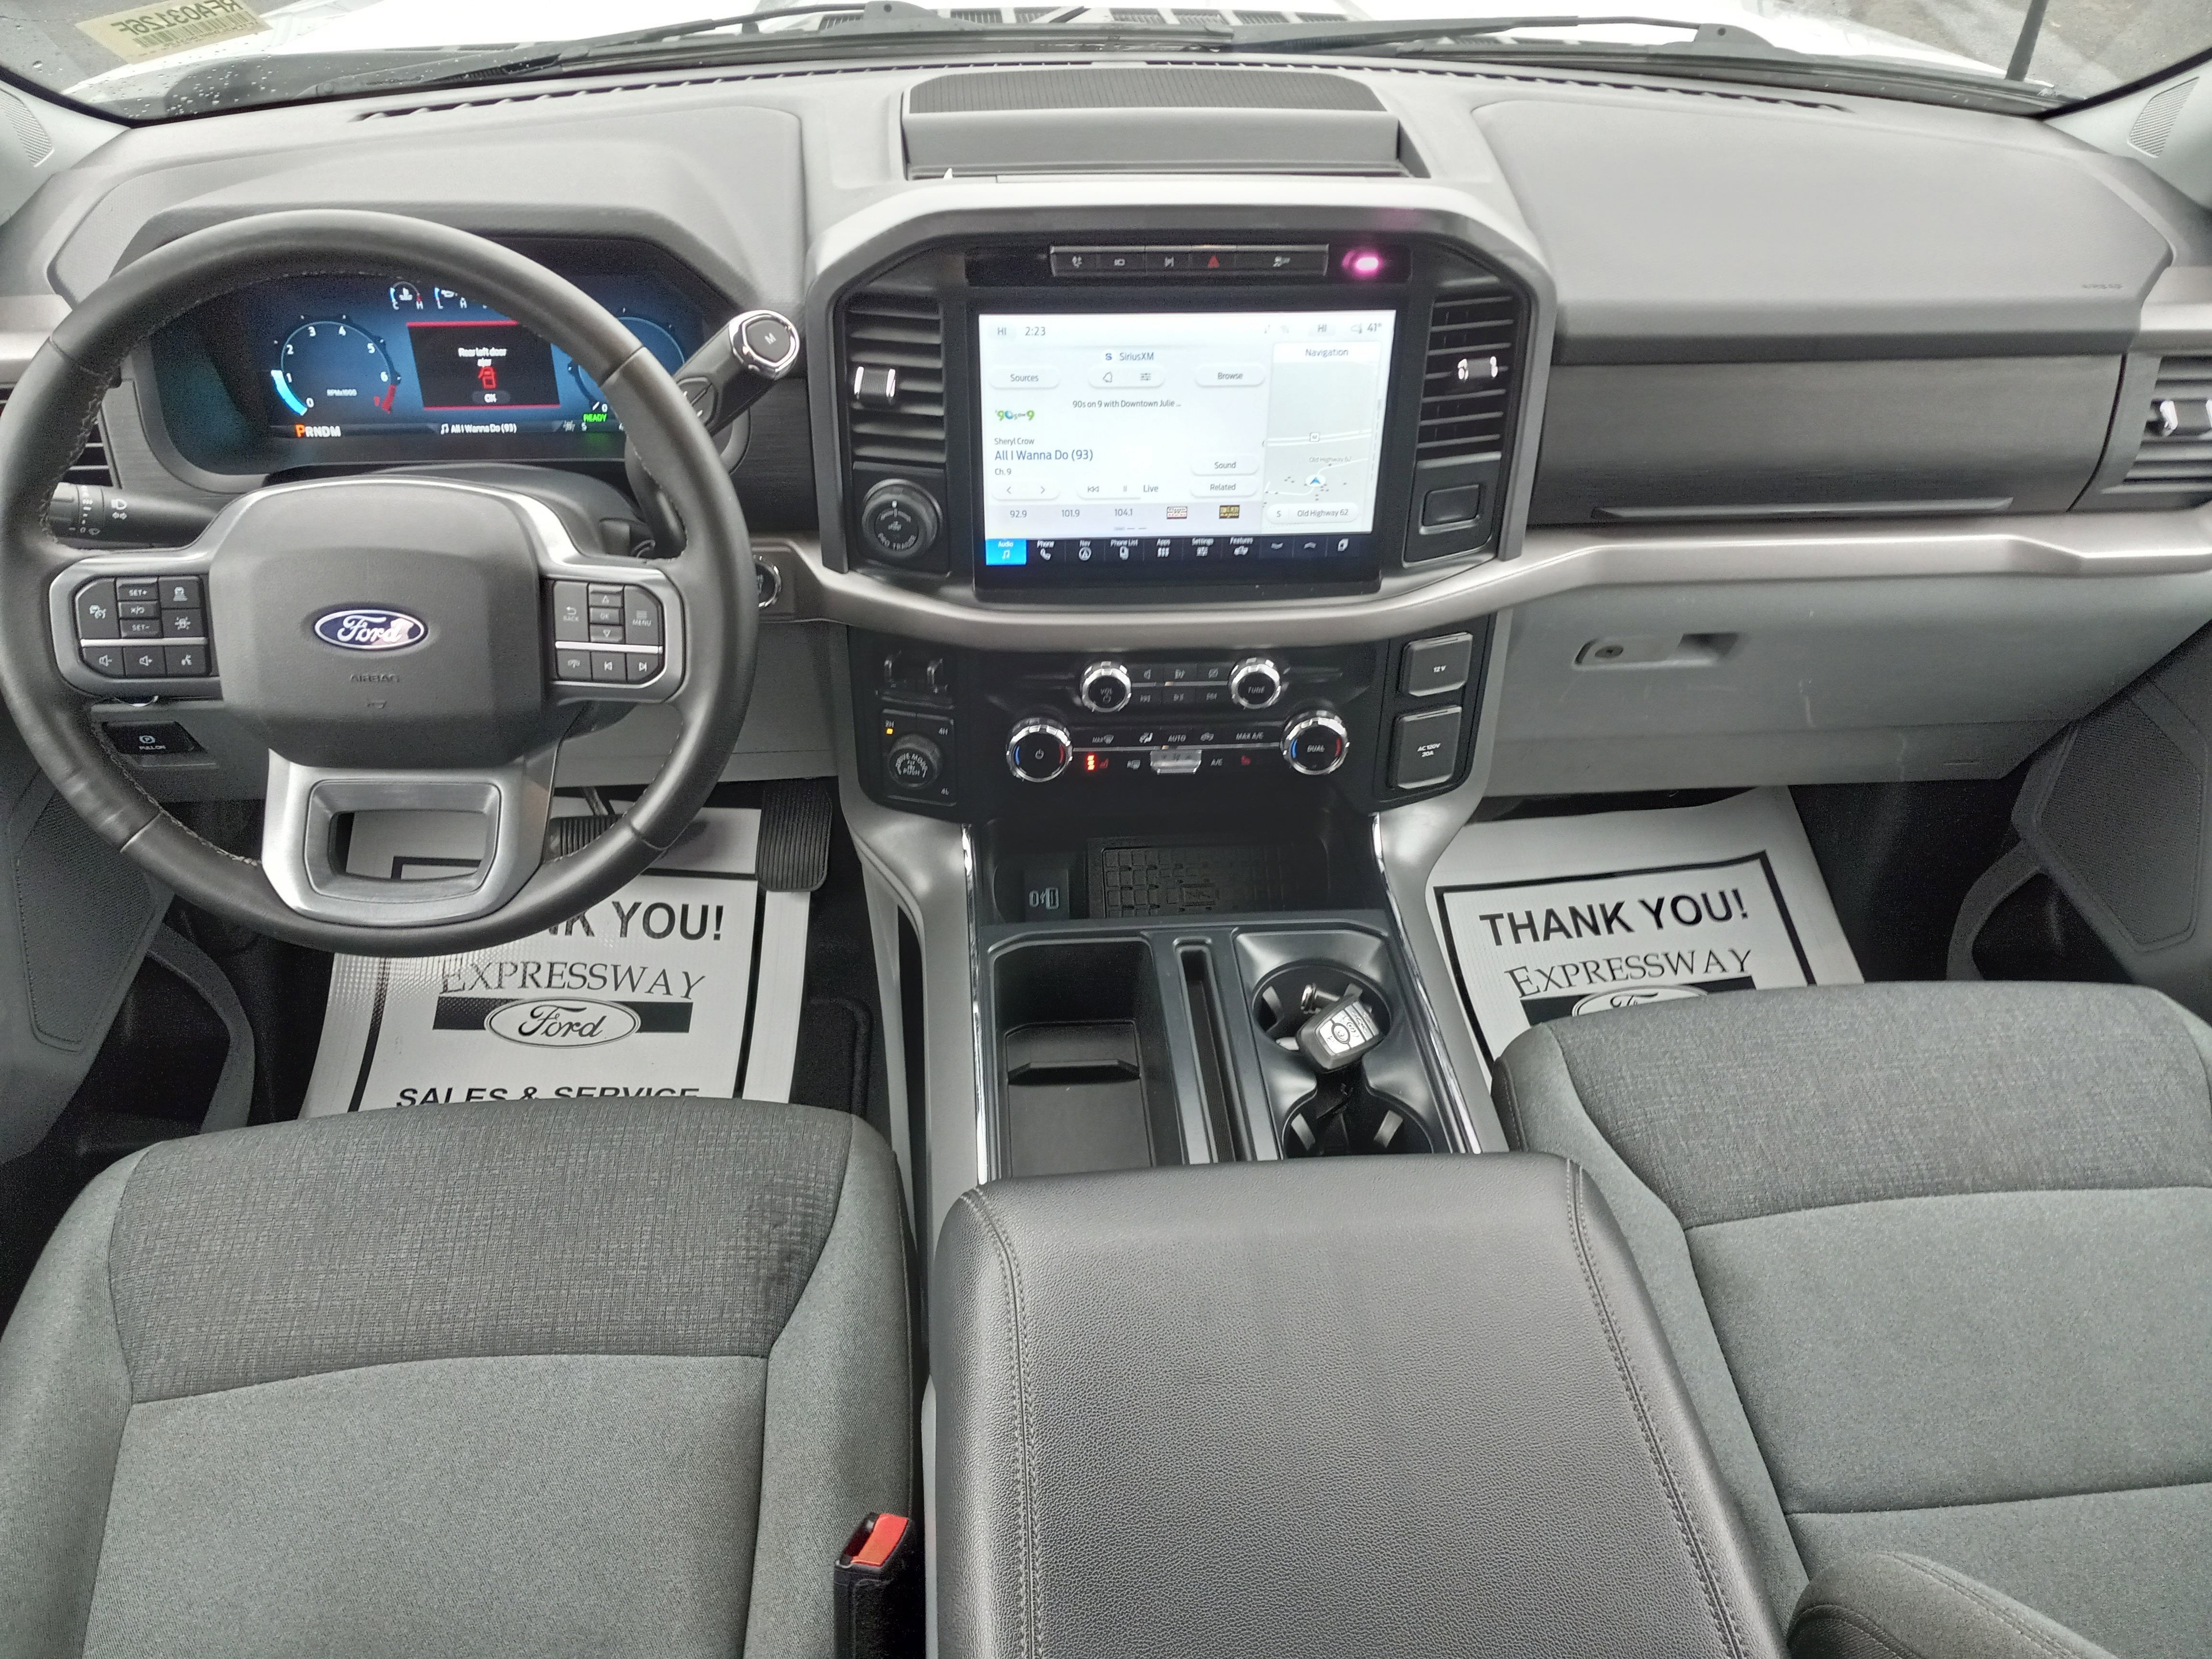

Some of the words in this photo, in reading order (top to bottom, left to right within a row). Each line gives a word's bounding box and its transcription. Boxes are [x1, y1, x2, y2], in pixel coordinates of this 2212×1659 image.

[308, 326, 316, 337] 3
[338, 326, 346, 336] 4
[997, 327, 1007, 336] HI
[1024, 326, 1046, 336] 2:23
[1317, 324, 1327, 333] HI
[764, 332, 777, 345] M
[287, 345, 294, 355] 2
[367, 343, 375, 353] 5
[1305, 348, 1348, 358] Navigation
[1119, 352, 1154, 361] SiriusXM
[287, 373, 292, 383] 1
[380, 372, 388, 382] 6
[1010, 374, 1039, 382] Sources
[1217, 372, 1243, 380] Browse
[306, 397, 314, 408] 0
[583, 413, 607, 422] READY
[995, 450, 1009, 461] All
[1016, 450, 1052, 460] Wanna
[1055, 450, 1069, 460] Do
[1071, 449, 1094, 461] (93)
[1214, 461, 1237, 469] Sound
[1143, 484, 1159, 493] Live
[1210, 483, 1236, 491] Related
[1010, 510, 1027, 518] 92.9
[1061, 509, 1080, 517] 101.9
[1115, 508, 1133, 517] 104.1
[1310, 508, 1338, 518] Highway
[1340, 508, 1348, 516] 62
[1156, 538, 1170, 546] Apps
[1191, 537, 1214, 546] Settings
[1230, 537, 1253, 545] Features
[337, 615, 404, 643] Ford
[1251, 732, 1264, 740] A/C
[612, 901, 724, 941] YOU!
[1479, 901, 1635, 947] THANK
[1638, 888, 1750, 931] YOU!
[1504, 949, 1752, 998] EXPRESSWAY
[439, 959, 706, 1000] EXPRESSWAY
[517, 1004, 606, 1039] Ford
